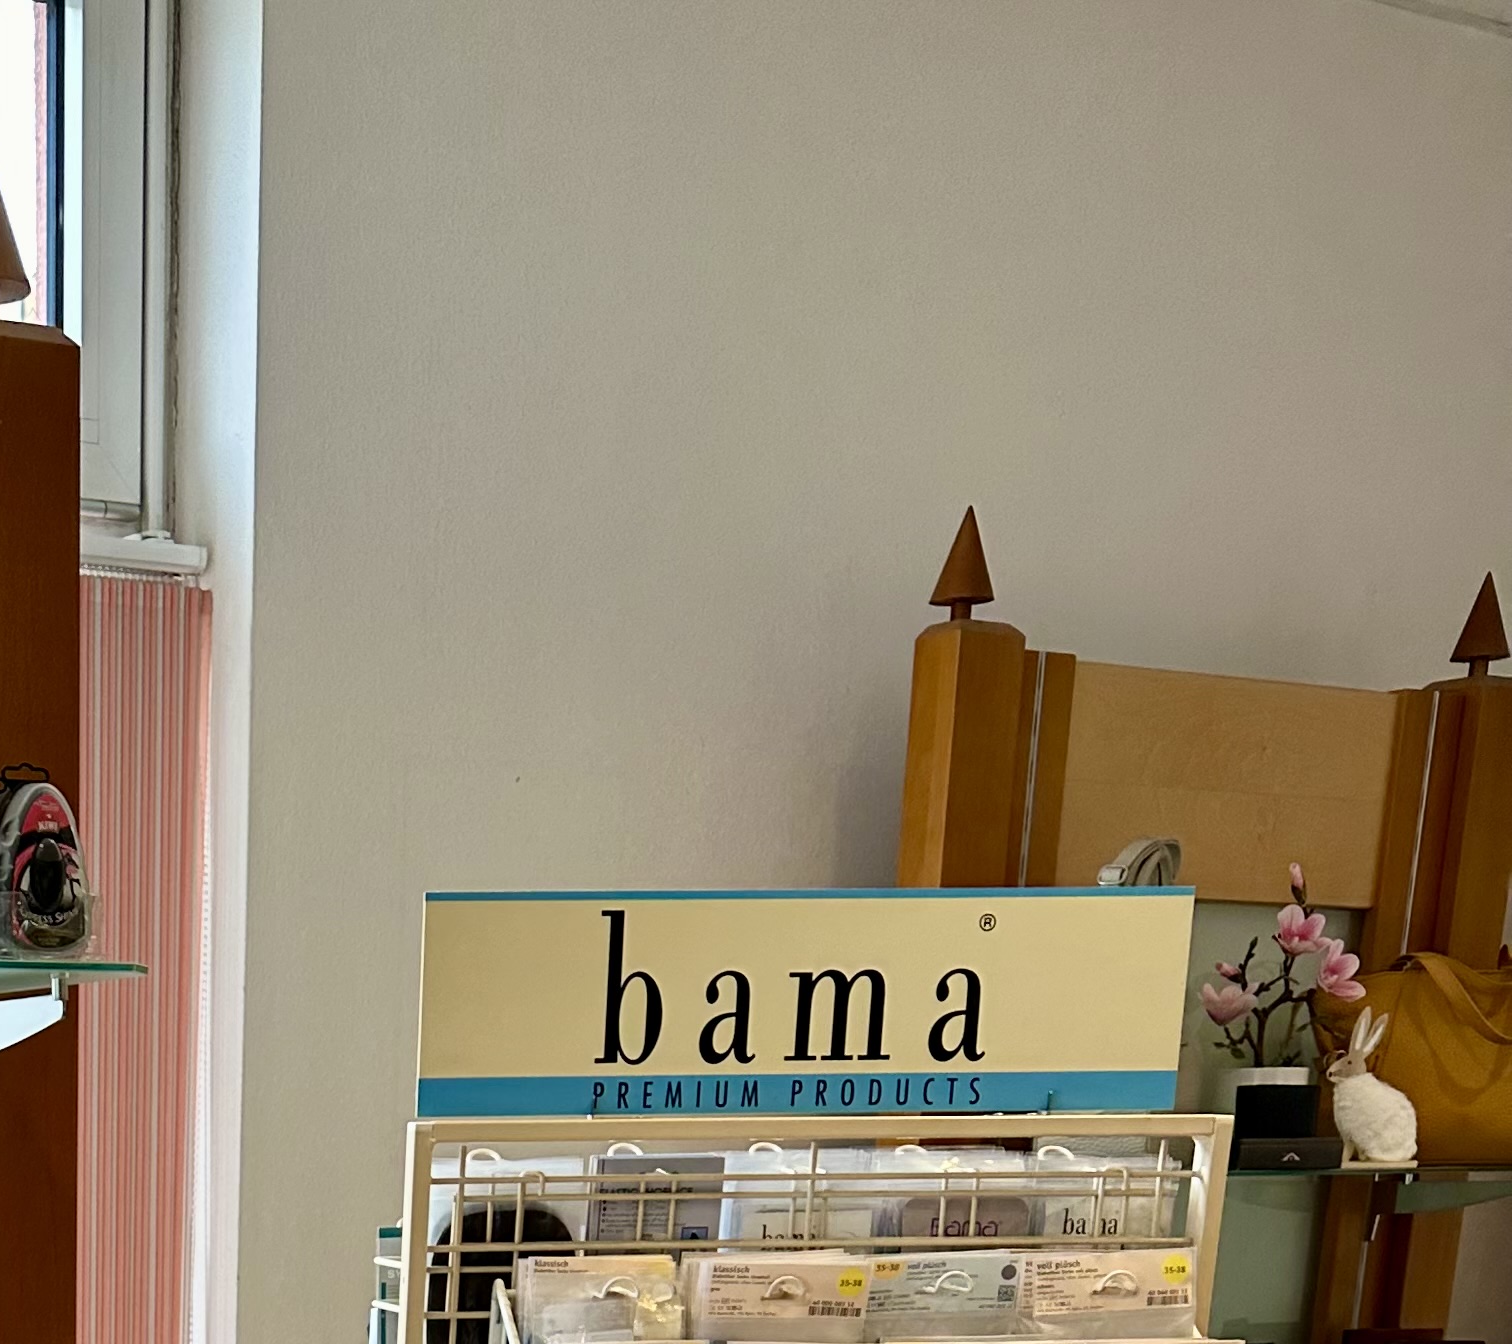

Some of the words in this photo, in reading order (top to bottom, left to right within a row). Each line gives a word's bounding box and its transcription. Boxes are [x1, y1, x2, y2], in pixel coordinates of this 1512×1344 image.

[593, 908, 986, 1067] bama
[592, 1079, 762, 1111] PREMIUM
[790, 1076, 985, 1108] PRODUCTS
[712, 1265, 750, 1274] klassisch
[1163, 1265, 1187, 1275] 35-38
[839, 1278, 863, 1288] 35-38
